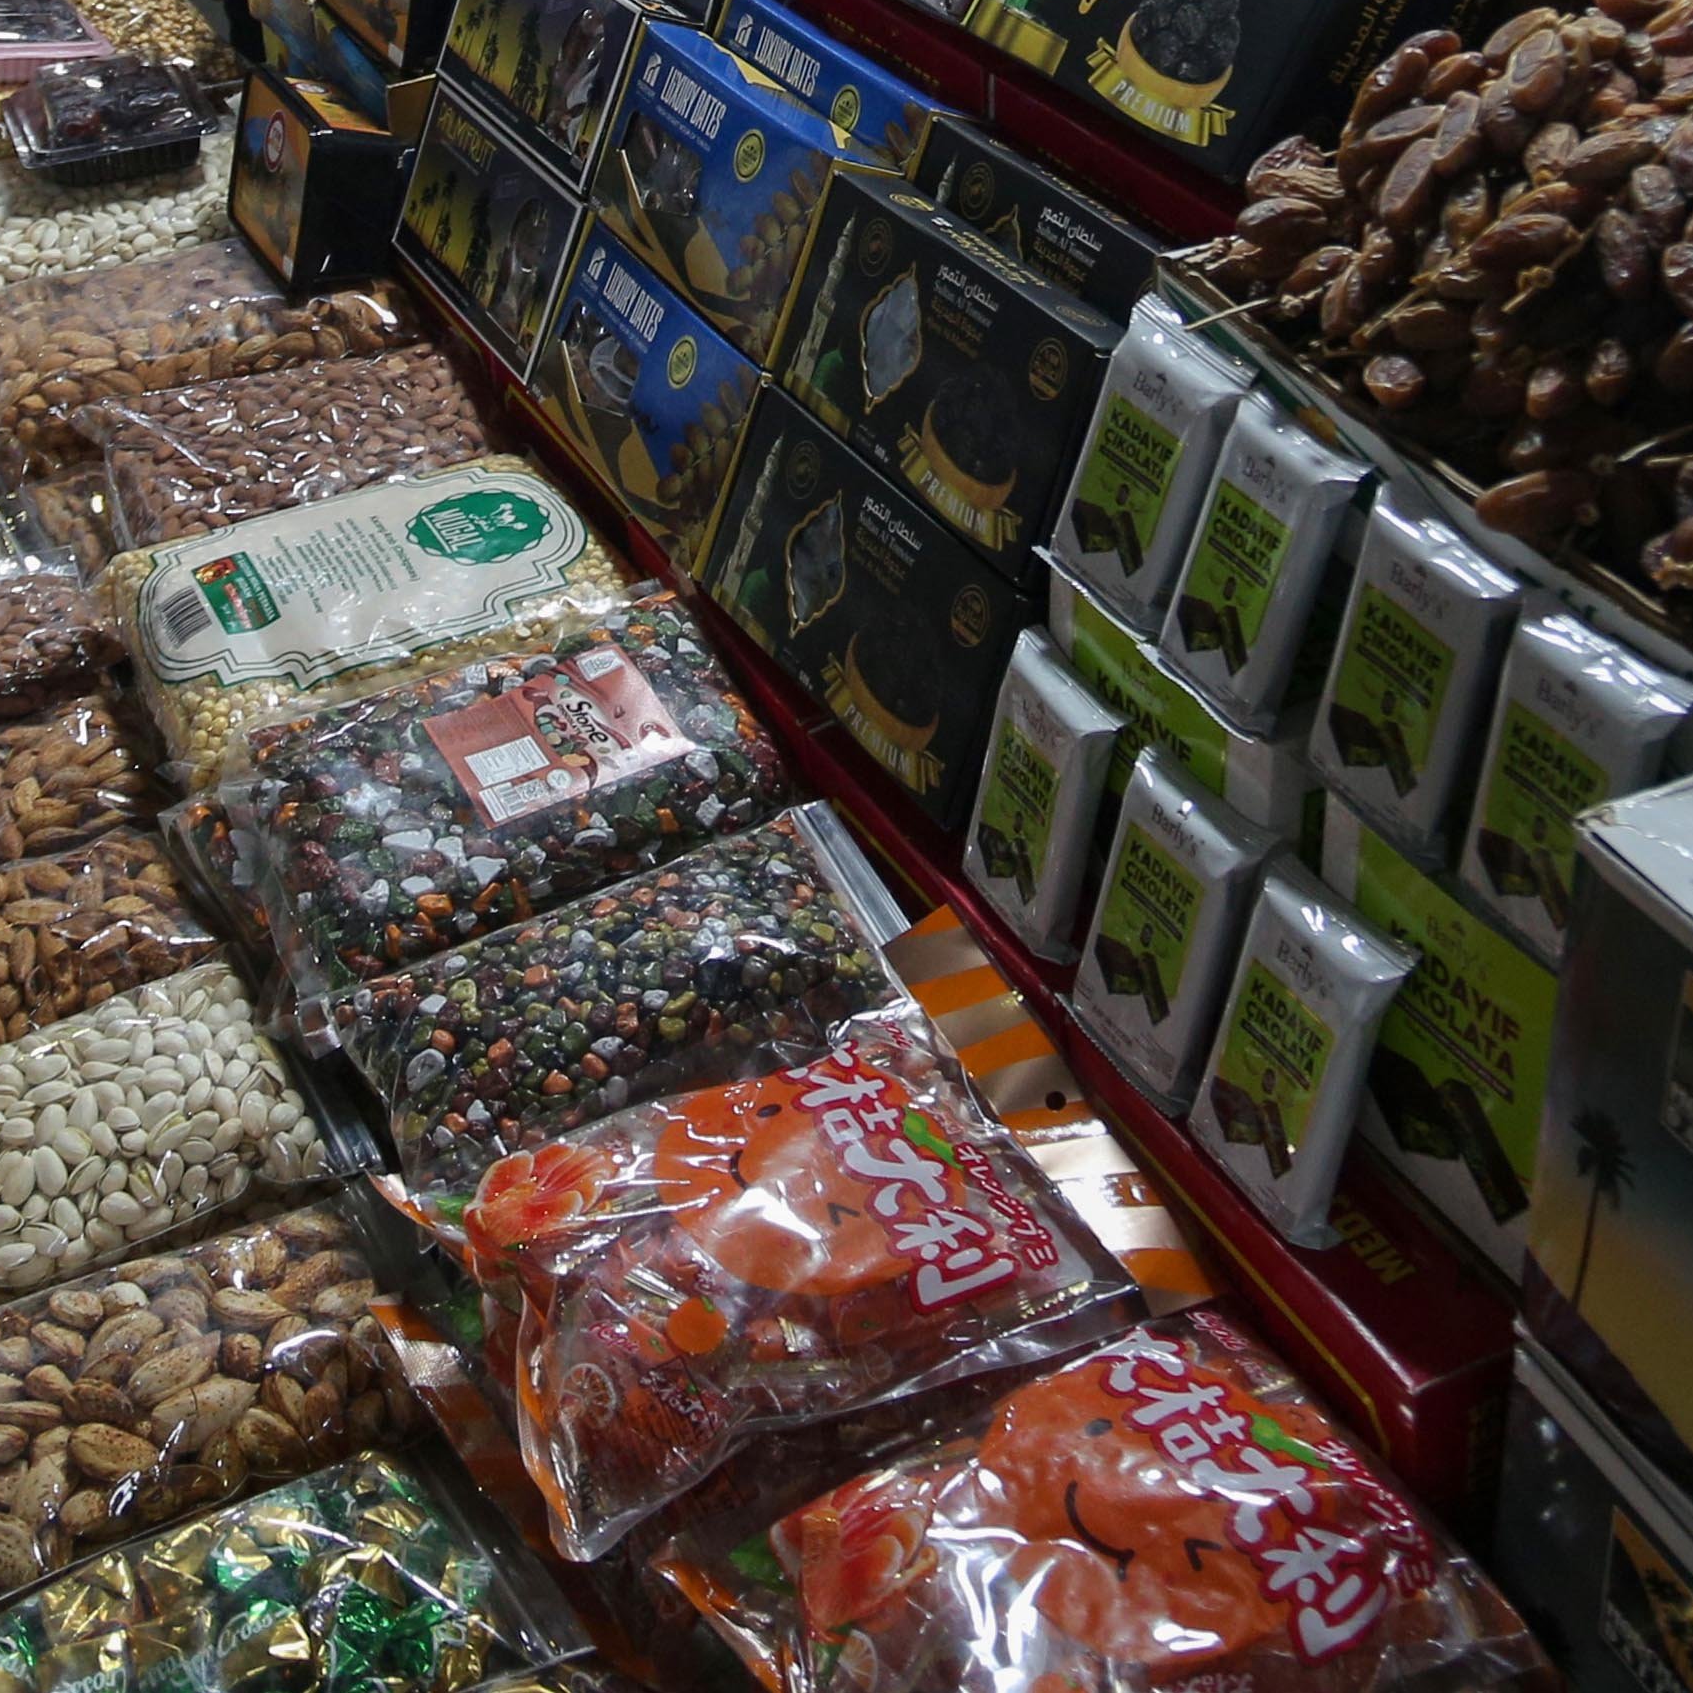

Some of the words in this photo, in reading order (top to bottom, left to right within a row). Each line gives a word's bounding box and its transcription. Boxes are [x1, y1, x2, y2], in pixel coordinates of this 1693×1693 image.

[755, 25, 792, 78] LUXURY
[784, 47, 821, 98] DATES
[660, 65, 698, 120] LUXURY
[691, 89, 727, 140] DATES
[1109, 81, 1191, 135] PREMIUM
[603, 262, 639, 319] LUXURY
[631, 290, 664, 343] DATES
[1132, 370, 1183, 416] Barly's
[1109, 408, 1174, 464] KADAYIF
[431, 507, 485, 554] MUGAL
[919, 470, 987, 536] PREMIUM
[1217, 494, 1282, 552] KADAYIF
[563, 697, 610, 749] Stone
[1151, 804, 1206, 858] Barly's
[1128, 839, 1196, 903] KADAYIF
[1250, 976, 1325, 1054] KADAYIF
